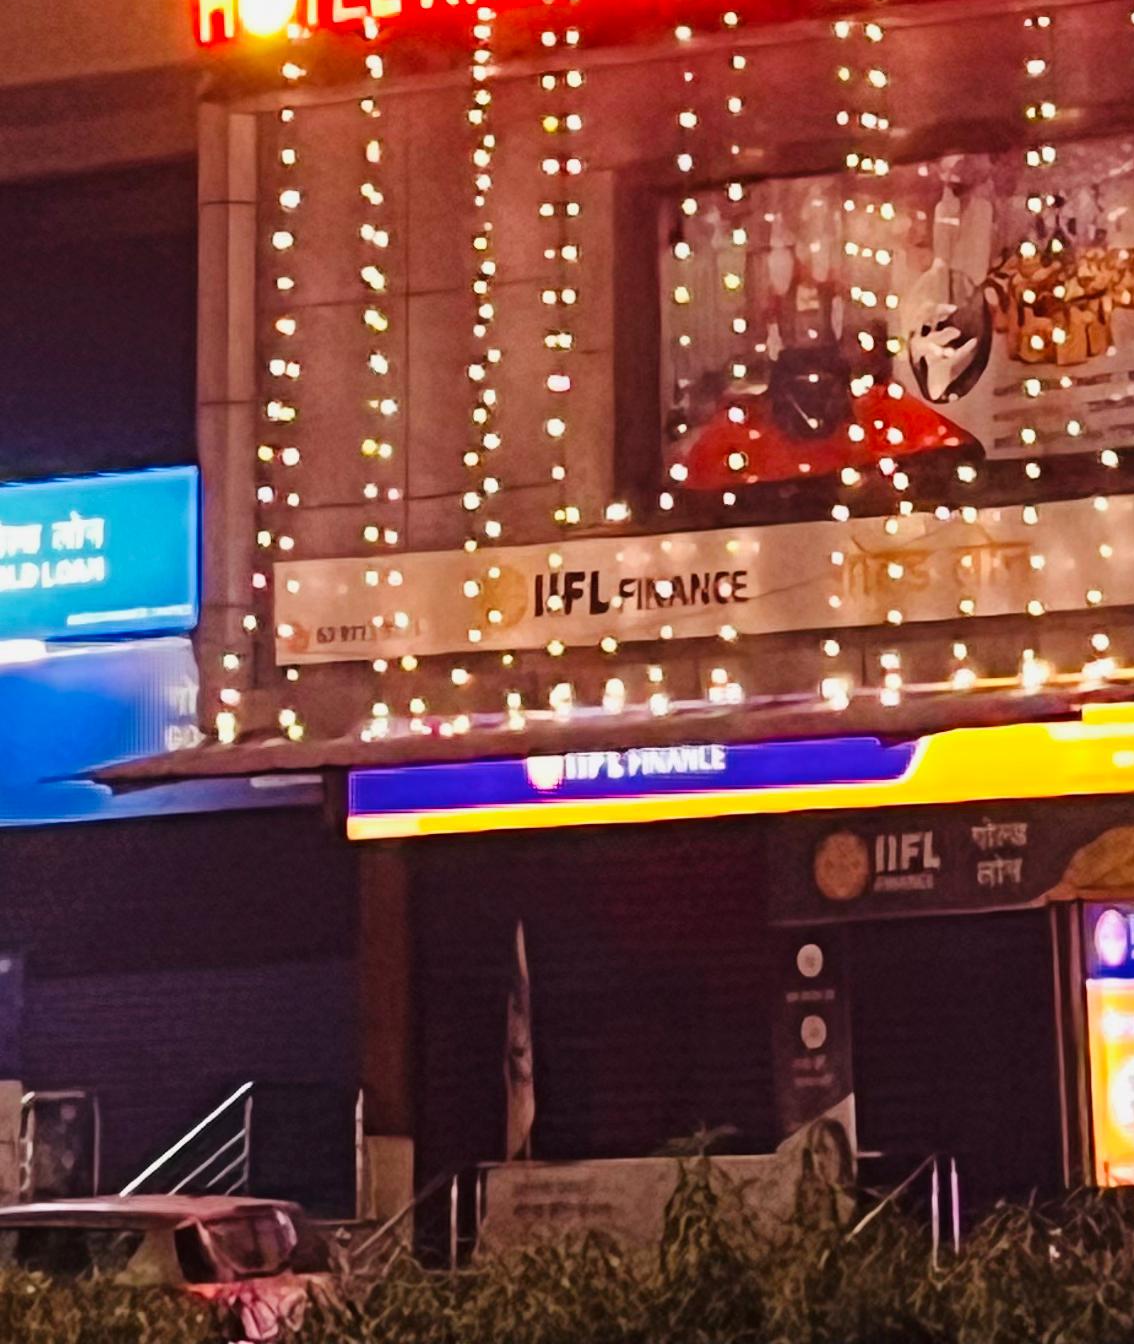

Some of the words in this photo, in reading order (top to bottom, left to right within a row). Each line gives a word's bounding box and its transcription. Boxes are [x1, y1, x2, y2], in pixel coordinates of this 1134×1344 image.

[534, 570, 610, 617] IIFL
[618, 570, 750, 611] FINANCE
[874, 831, 941, 873] IIFL
